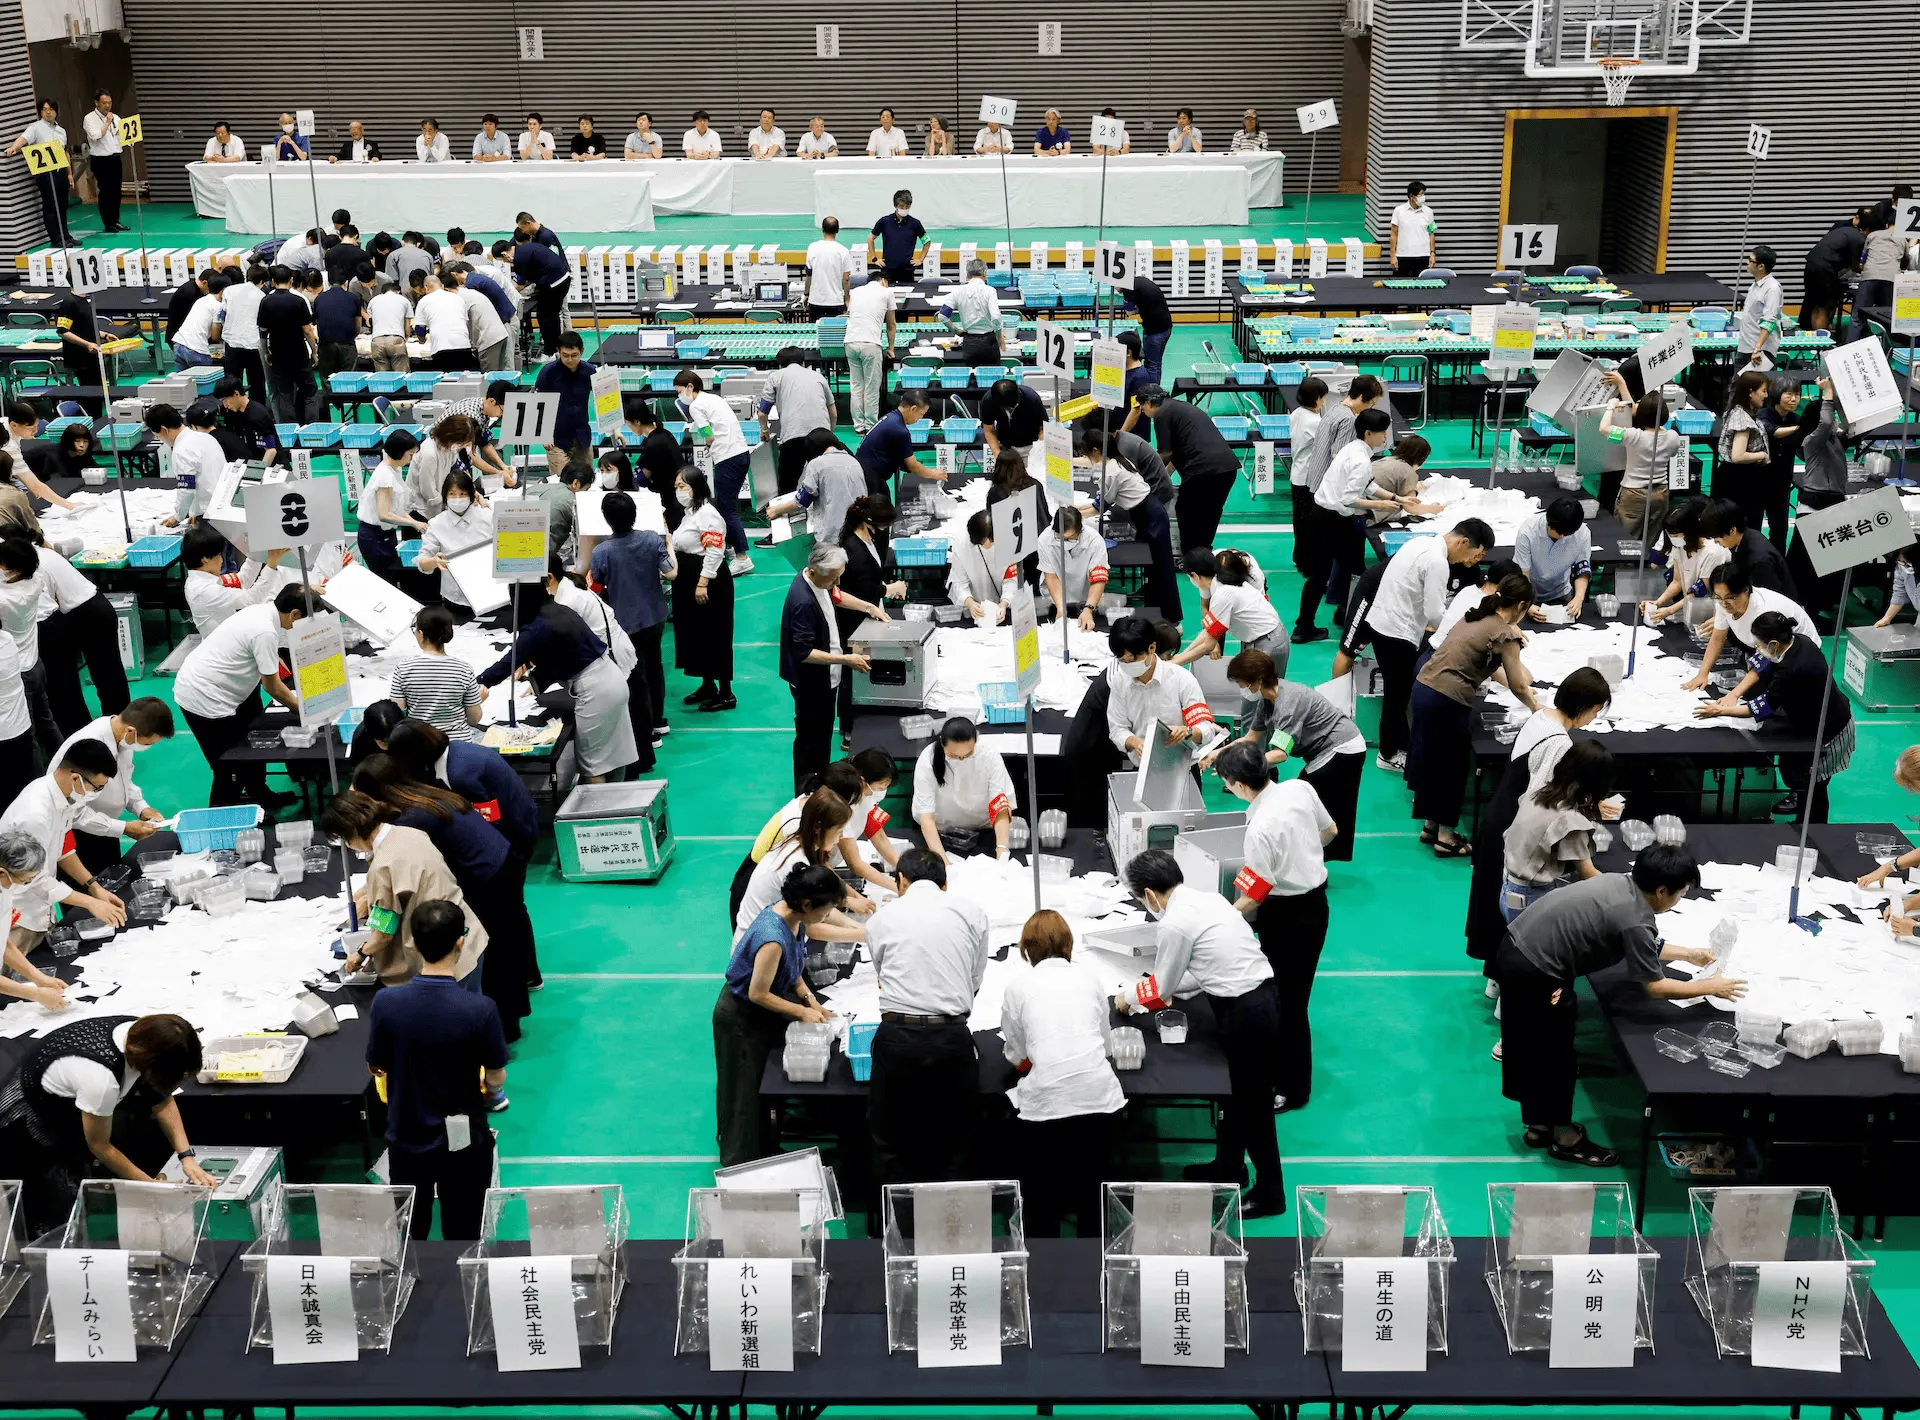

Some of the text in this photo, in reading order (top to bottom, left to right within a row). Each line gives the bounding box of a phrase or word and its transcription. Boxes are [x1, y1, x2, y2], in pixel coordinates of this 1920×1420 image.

[525, 29, 536, 58] 開票立会人
[989, 104, 1008, 117] 30
[1307, 109, 1327, 123] 29
[123, 120, 138, 141] 23
[1099, 124, 1117, 138] 28
[1751, 130, 1768, 152] 27
[31, 146, 58, 168] 21
[1102, 249, 1126, 279] 15
[1514, 231, 1543, 259] 16
[76, 255, 100, 286] 13
[1177, 257, 1185, 295] れいわ新選組
[1044, 329, 1066, 370] 12
[1852, 352, 1876, 398] 比例代表選出
[515, 402, 545, 437] 11
[344, 452, 358, 500] れいわ新選組
[1257, 455, 1267, 483] 参政党
[1676, 440, 1685, 487] 国民民主党
[280, 493, 309, 537] 8
[1012, 507, 1023, 555] 9
[1818, 511, 1892, 549] 作業台⑥
[580, 842, 640, 854] 比例代表選出
[79, 1255, 105, 1358] チームみらい
[300, 1264, 324, 1345] 日本誠真会
[520, 1266, 546, 1355] 社会民主党
[739, 1262, 760, 1368] れいわ新選組
[949, 1266, 968, 1351] 日本改革党
[1173, 1269, 1191, 1356] 自由民主党
[1375, 1270, 1394, 1341] 再生の道
[1583, 1268, 1604, 1339] 公明党
[1786, 1276, 1811, 1339] NHK党
